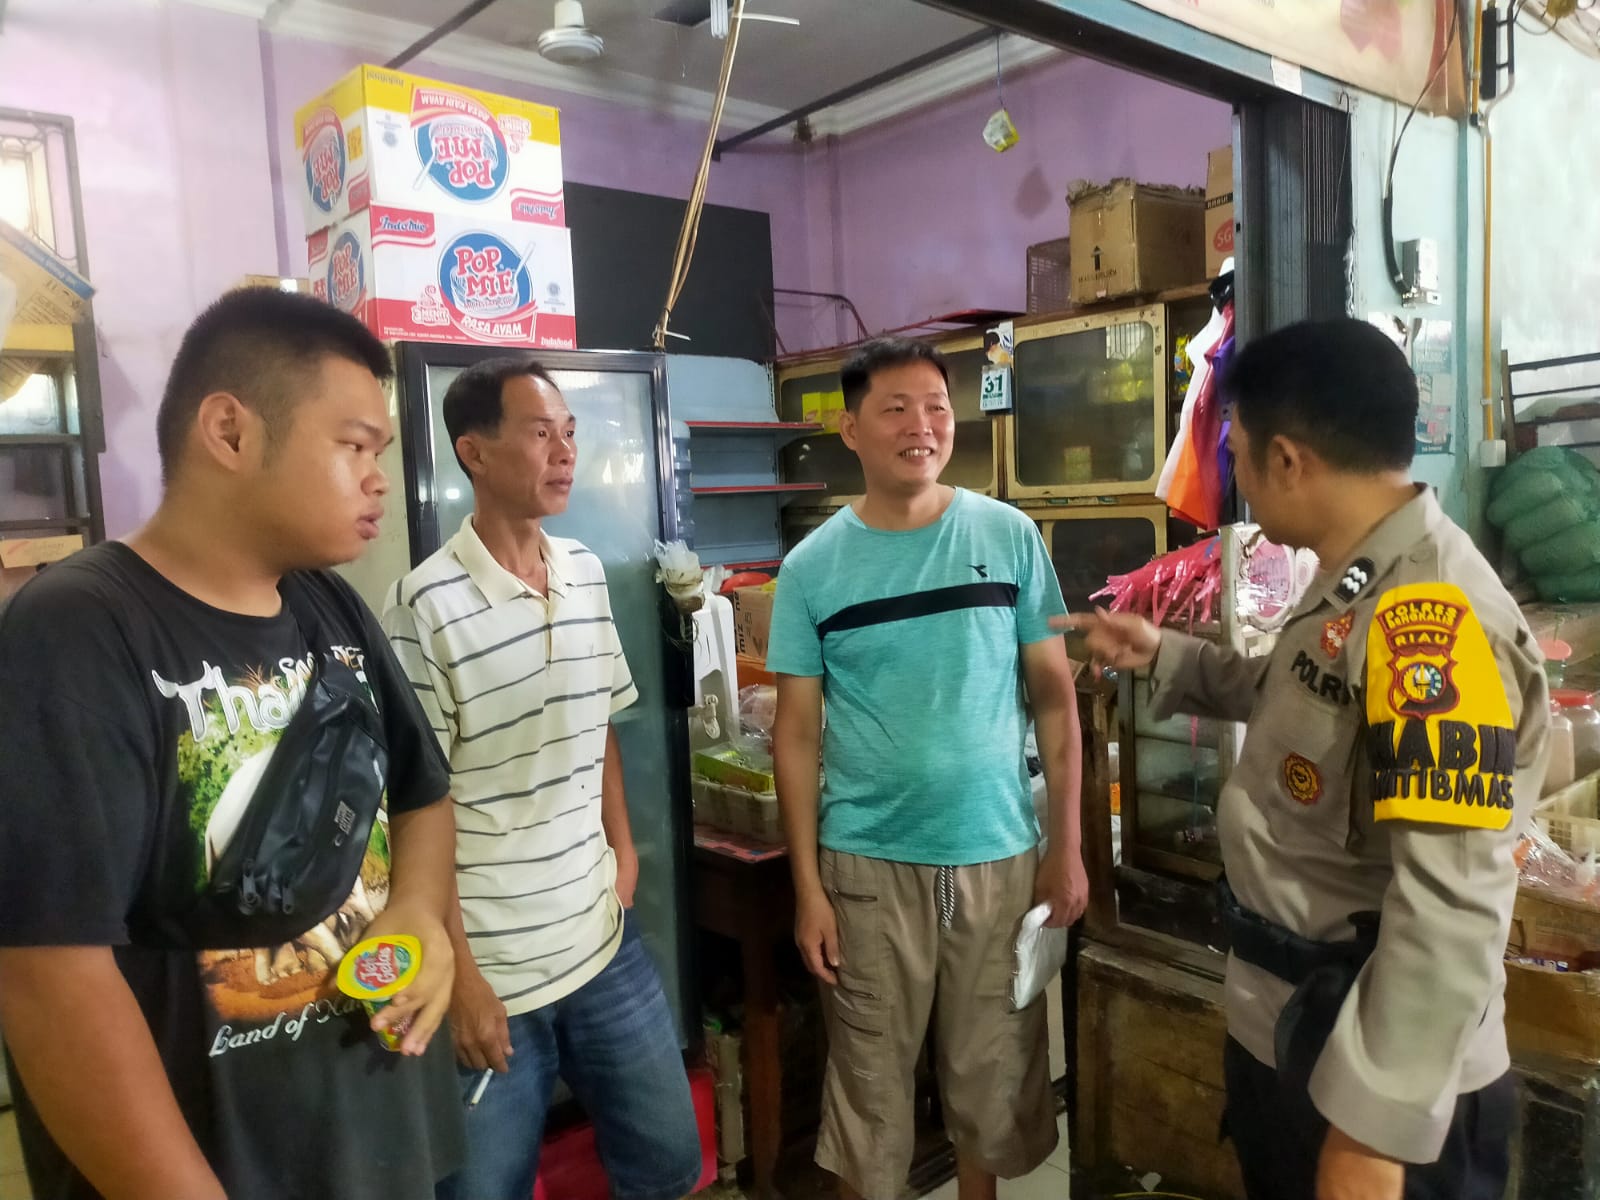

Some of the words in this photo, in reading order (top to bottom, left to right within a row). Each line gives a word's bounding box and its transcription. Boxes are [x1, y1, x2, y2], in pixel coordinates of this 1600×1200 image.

[434, 136, 483, 162] MIE
[449, 159, 495, 188] POP
[455, 247, 501, 276] POP
[466, 270, 514, 297] MIE
[461, 315, 491, 333] RASA
[492, 322, 523, 336] AYAM
[984, 374, 1004, 393] 31
[1384, 602, 1458, 621] POLRES
[1394, 631, 1449, 647] RIAU
[208, 1012, 287, 1058] Land
[285, 1002, 315, 1041] of
